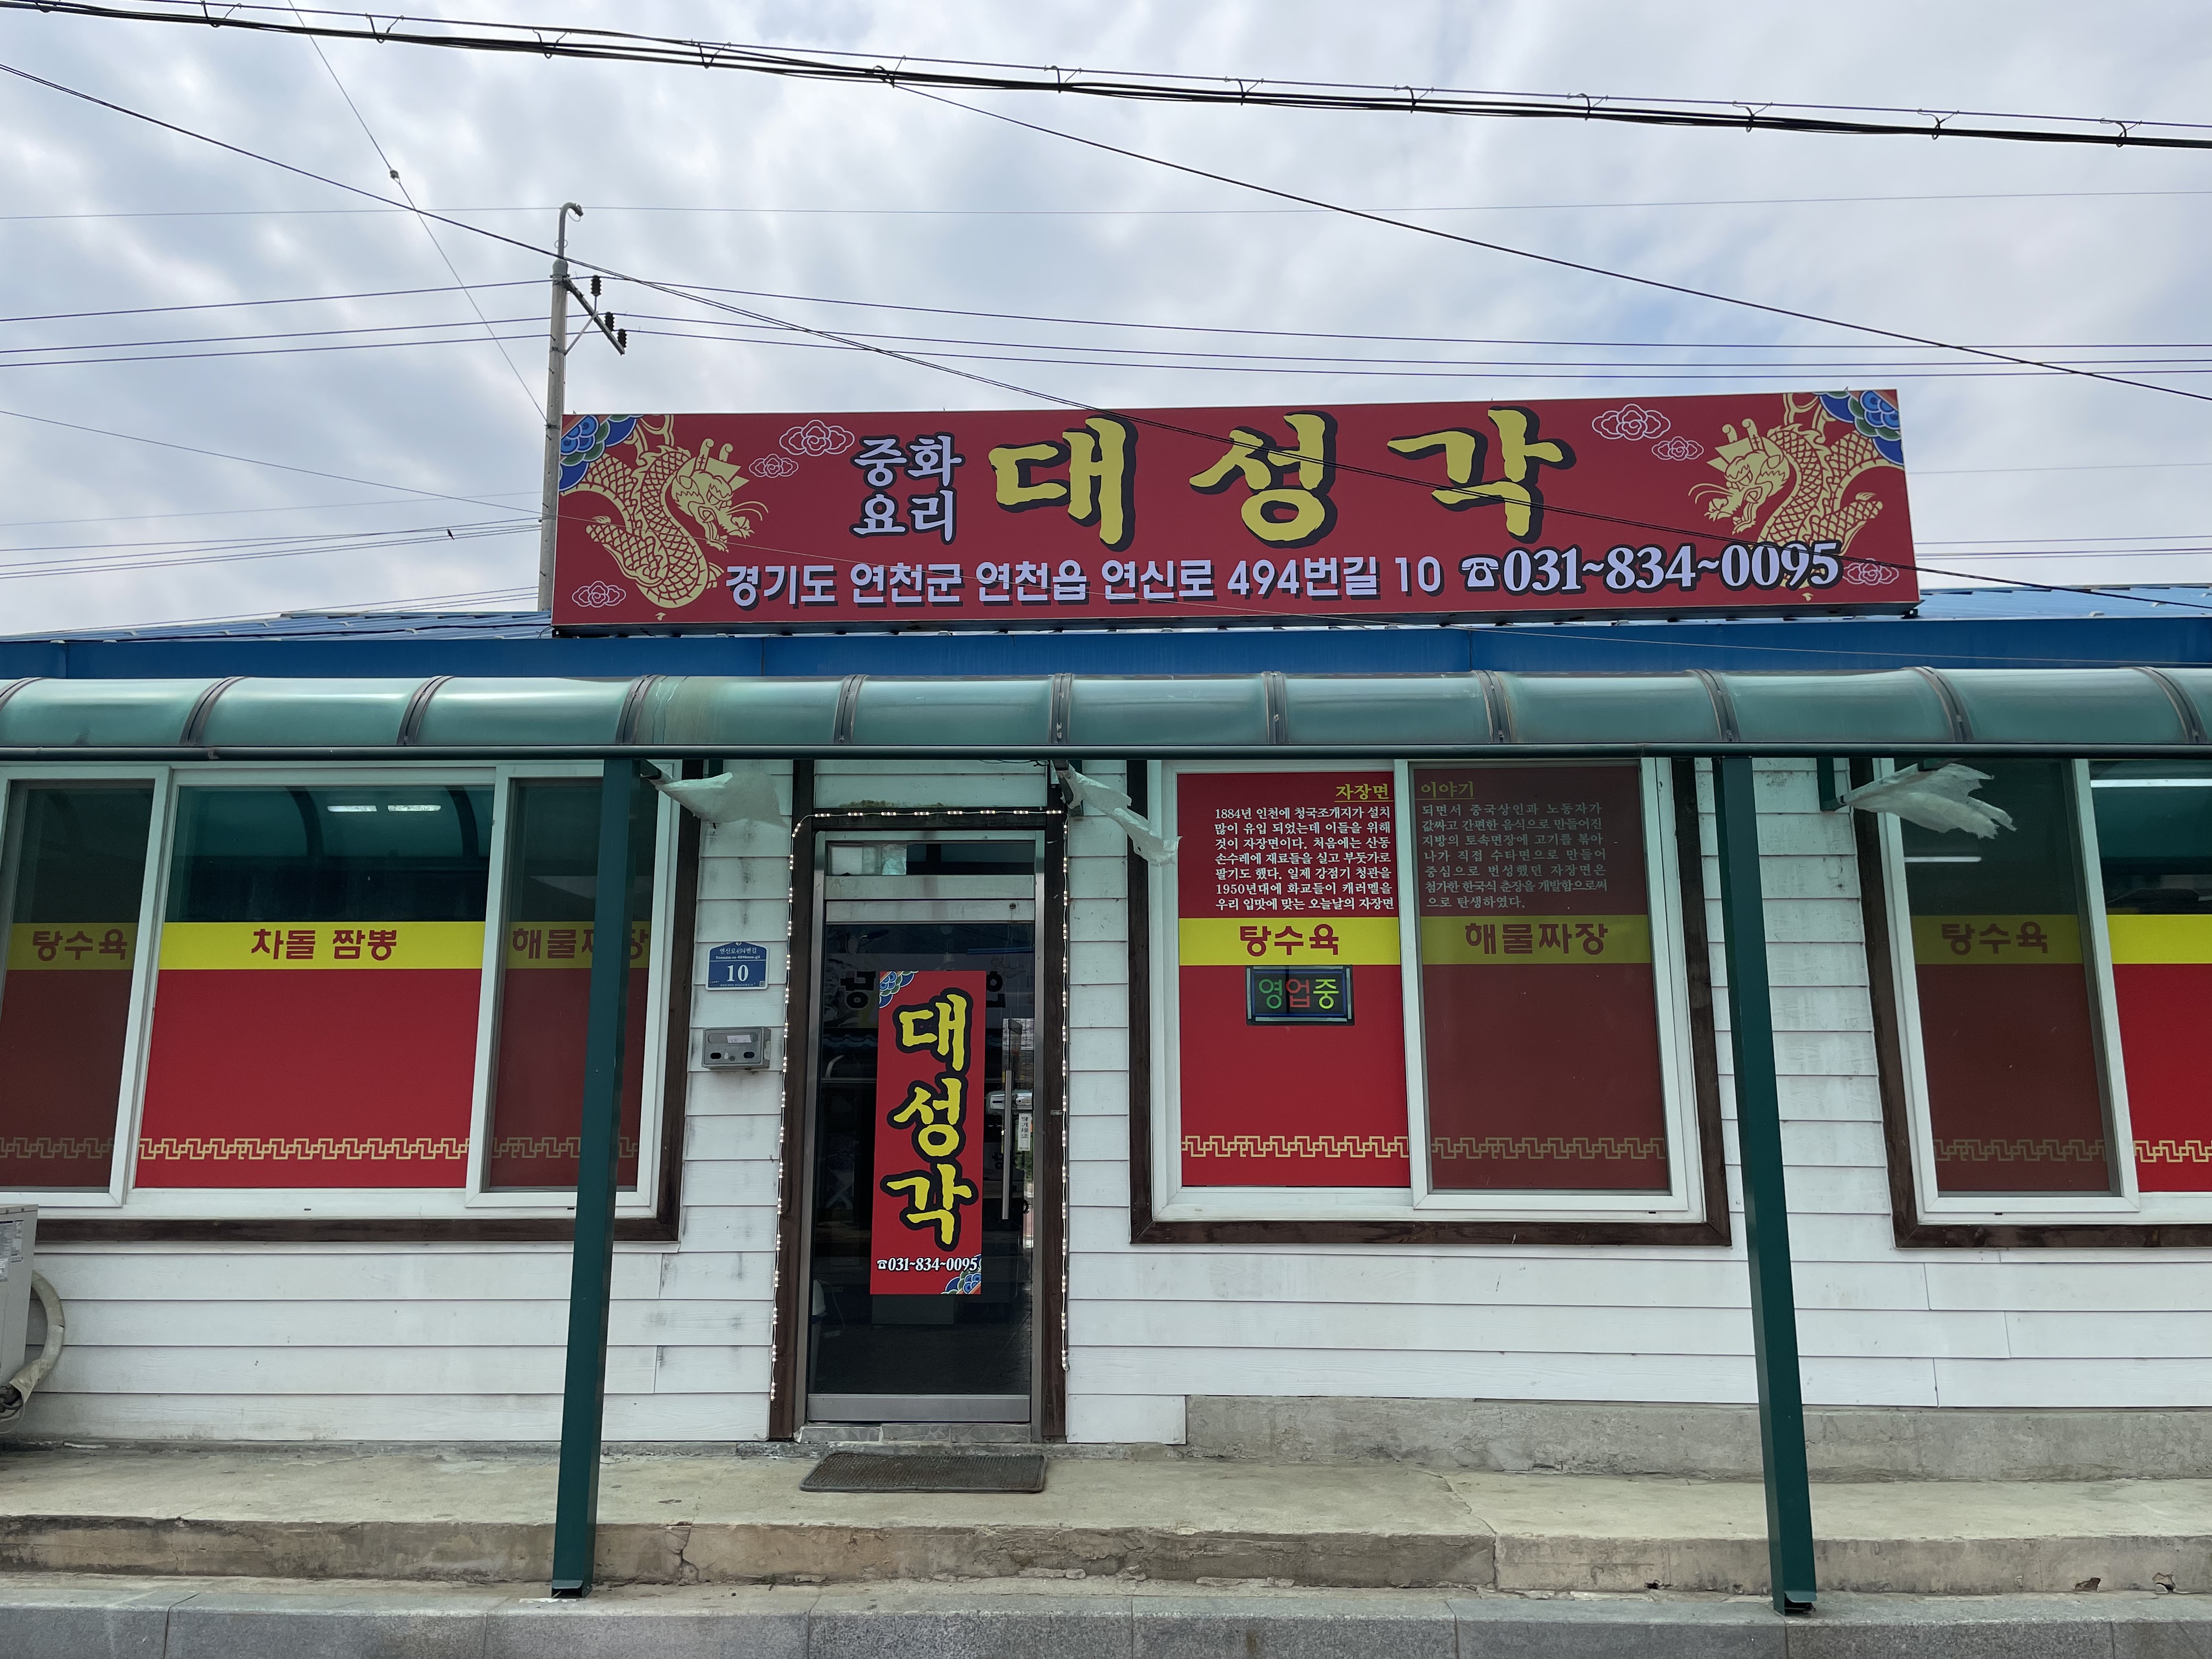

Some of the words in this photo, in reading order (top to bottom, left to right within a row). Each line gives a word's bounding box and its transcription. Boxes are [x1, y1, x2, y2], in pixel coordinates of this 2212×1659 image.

[854, 435, 962, 487] 중화
[853, 489, 954, 543] 요리
[726, 565, 835, 606] 경기도
[850, 562, 961, 603] 연천군
[976, 560, 1086, 601] 연천읍
[1102, 560, 1214, 600] 연신로
[1227, 557, 1378, 596] 494번길
[1396, 556, 1440, 592] 10
[1335, 783, 1389, 800] 자장면
[1421, 781, 1474, 799] 이야기
[1215, 806, 1252, 820] 1884년
[1256, 806, 1290, 820] 인천에
[1368, 806, 1390, 820] 설치
[1423, 802, 1462, 817] 되면서
[1470, 802, 1539, 817] 중국상인과
[1547, 802, 1602, 817] 노동자가
[1215, 821, 1238, 835] 많이
[1243, 821, 1266, 835] 유입
[1272, 821, 1320, 835] 되었는데
[1325, 821, 1362, 835] 이들을
[1367, 821, 1390, 835] 위해
[1422, 819, 1458, 832] 값싸고
[1462, 819, 1498, 832] 간편한
[1502, 819, 1550, 832] 음식으로
[1554, 819, 1602, 832] 만들어진
[1215, 836, 1238, 850] 것이
[1243, 836, 1307, 850] 자장면이다.
[1313, 836, 1361, 850] 처음에는
[1365, 836, 1390, 850] 산동
[1423, 834, 1459, 848] 지방의
[1465, 834, 1528, 848] 토속면장에
[1534, 834, 1572, 848] 고기를
[1578, 834, 1604, 848] 볶아
[1215, 851, 1261, 865] 손수레에
[1266, 851, 1312, 865] 재료들을
[1317, 851, 1340, 865] 실고
[1344, 851, 1391, 865] 부둣가로
[1425, 849, 1451, 863] 나가
[1458, 849, 1482, 863] 직접
[1491, 849, 1559, 863] 수타면으로
[1567, 849, 1605, 863] 만들어
[1215, 867, 1251, 879] 팔기도
[1256, 867, 1282, 879] 했다.
[1288, 867, 1310, 879] 일제
[1316, 867, 1350, 879] 강점기
[1356, 867, 1391, 879] 청관을
[1425, 864, 1480, 877] 중심으로
[1488, 864, 1542, 877] 번성했던
[1551, 864, 1606, 877] 자장면은
[1216, 882, 1282, 895] 1950년대에
[1287, 882, 1336, 895] 화교들이
[1342, 882, 1392, 895] 캐러멜을
[1425, 879, 1460, 894] 첨가한
[1462, 879, 1496, 894] 한국식
[1500, 879, 1535, 894] 춘장을
[1538, 879, 1607, 894] 개발함으로써
[1216, 897, 1238, 910] 우리
[1244, 897, 1277, 910] 입맛에
[1282, 897, 1305, 910] 맞는
[1308, 897, 1355, 910] 오늘날의
[1359, 897, 1393, 910] 자장면
[1426, 896, 1452, 909] 으로
[1458, 896, 1525, 909] 탄생하였다.
[32, 928, 128, 962] 탕수육
[251, 928, 316, 960] 차돌
[332, 929, 397, 961] 짬뽕
[1239, 923, 1339, 957] 탕수육
[1465, 922, 1608, 955] 해물짜장
[1942, 921, 2048, 955] 탕수육
[727, 964, 748, 981] 10
[1259, 978, 1339, 1009] 영업중
[887, 994, 972, 1245] 대성각
